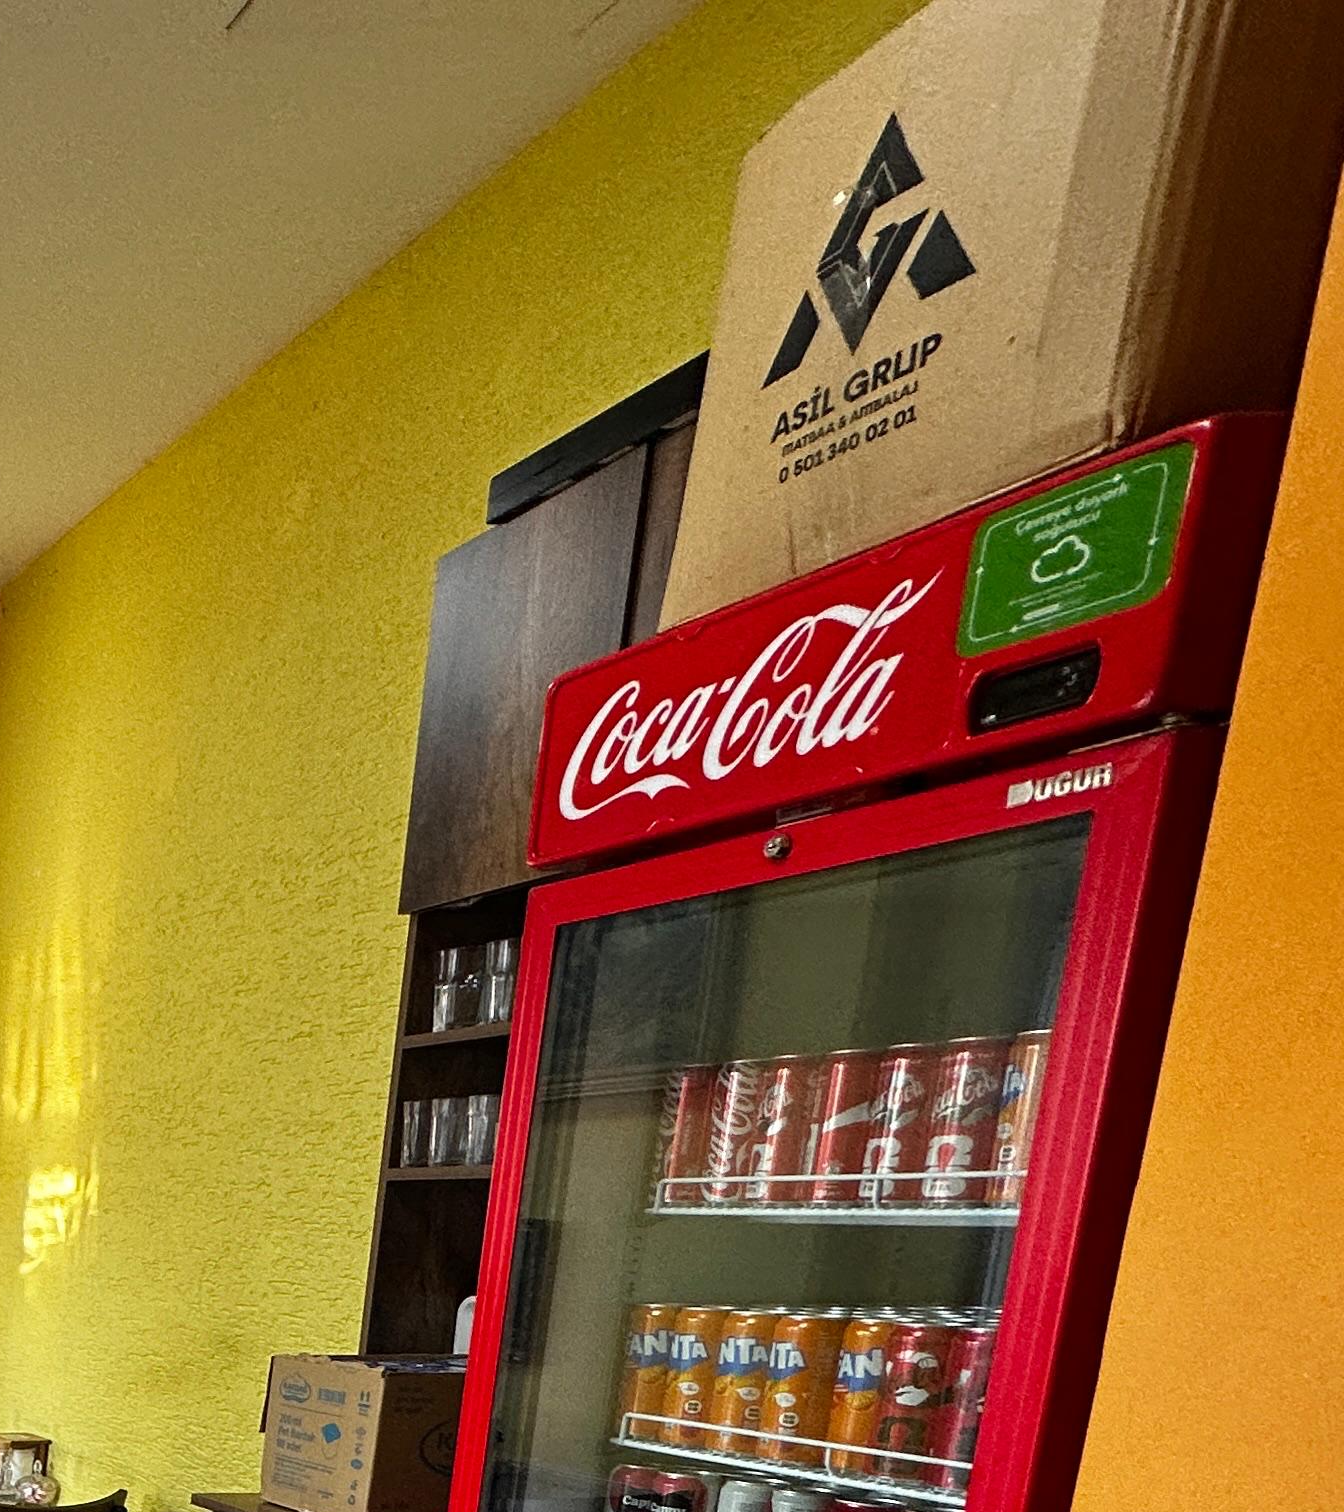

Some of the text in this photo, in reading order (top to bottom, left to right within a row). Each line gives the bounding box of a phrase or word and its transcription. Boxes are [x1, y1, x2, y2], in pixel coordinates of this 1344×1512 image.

[770, 333, 943, 445] ASİL GRUP
[778, 405, 917, 483] 0 501 340 02 01
[559, 565, 945, 821] Coca-Cola
